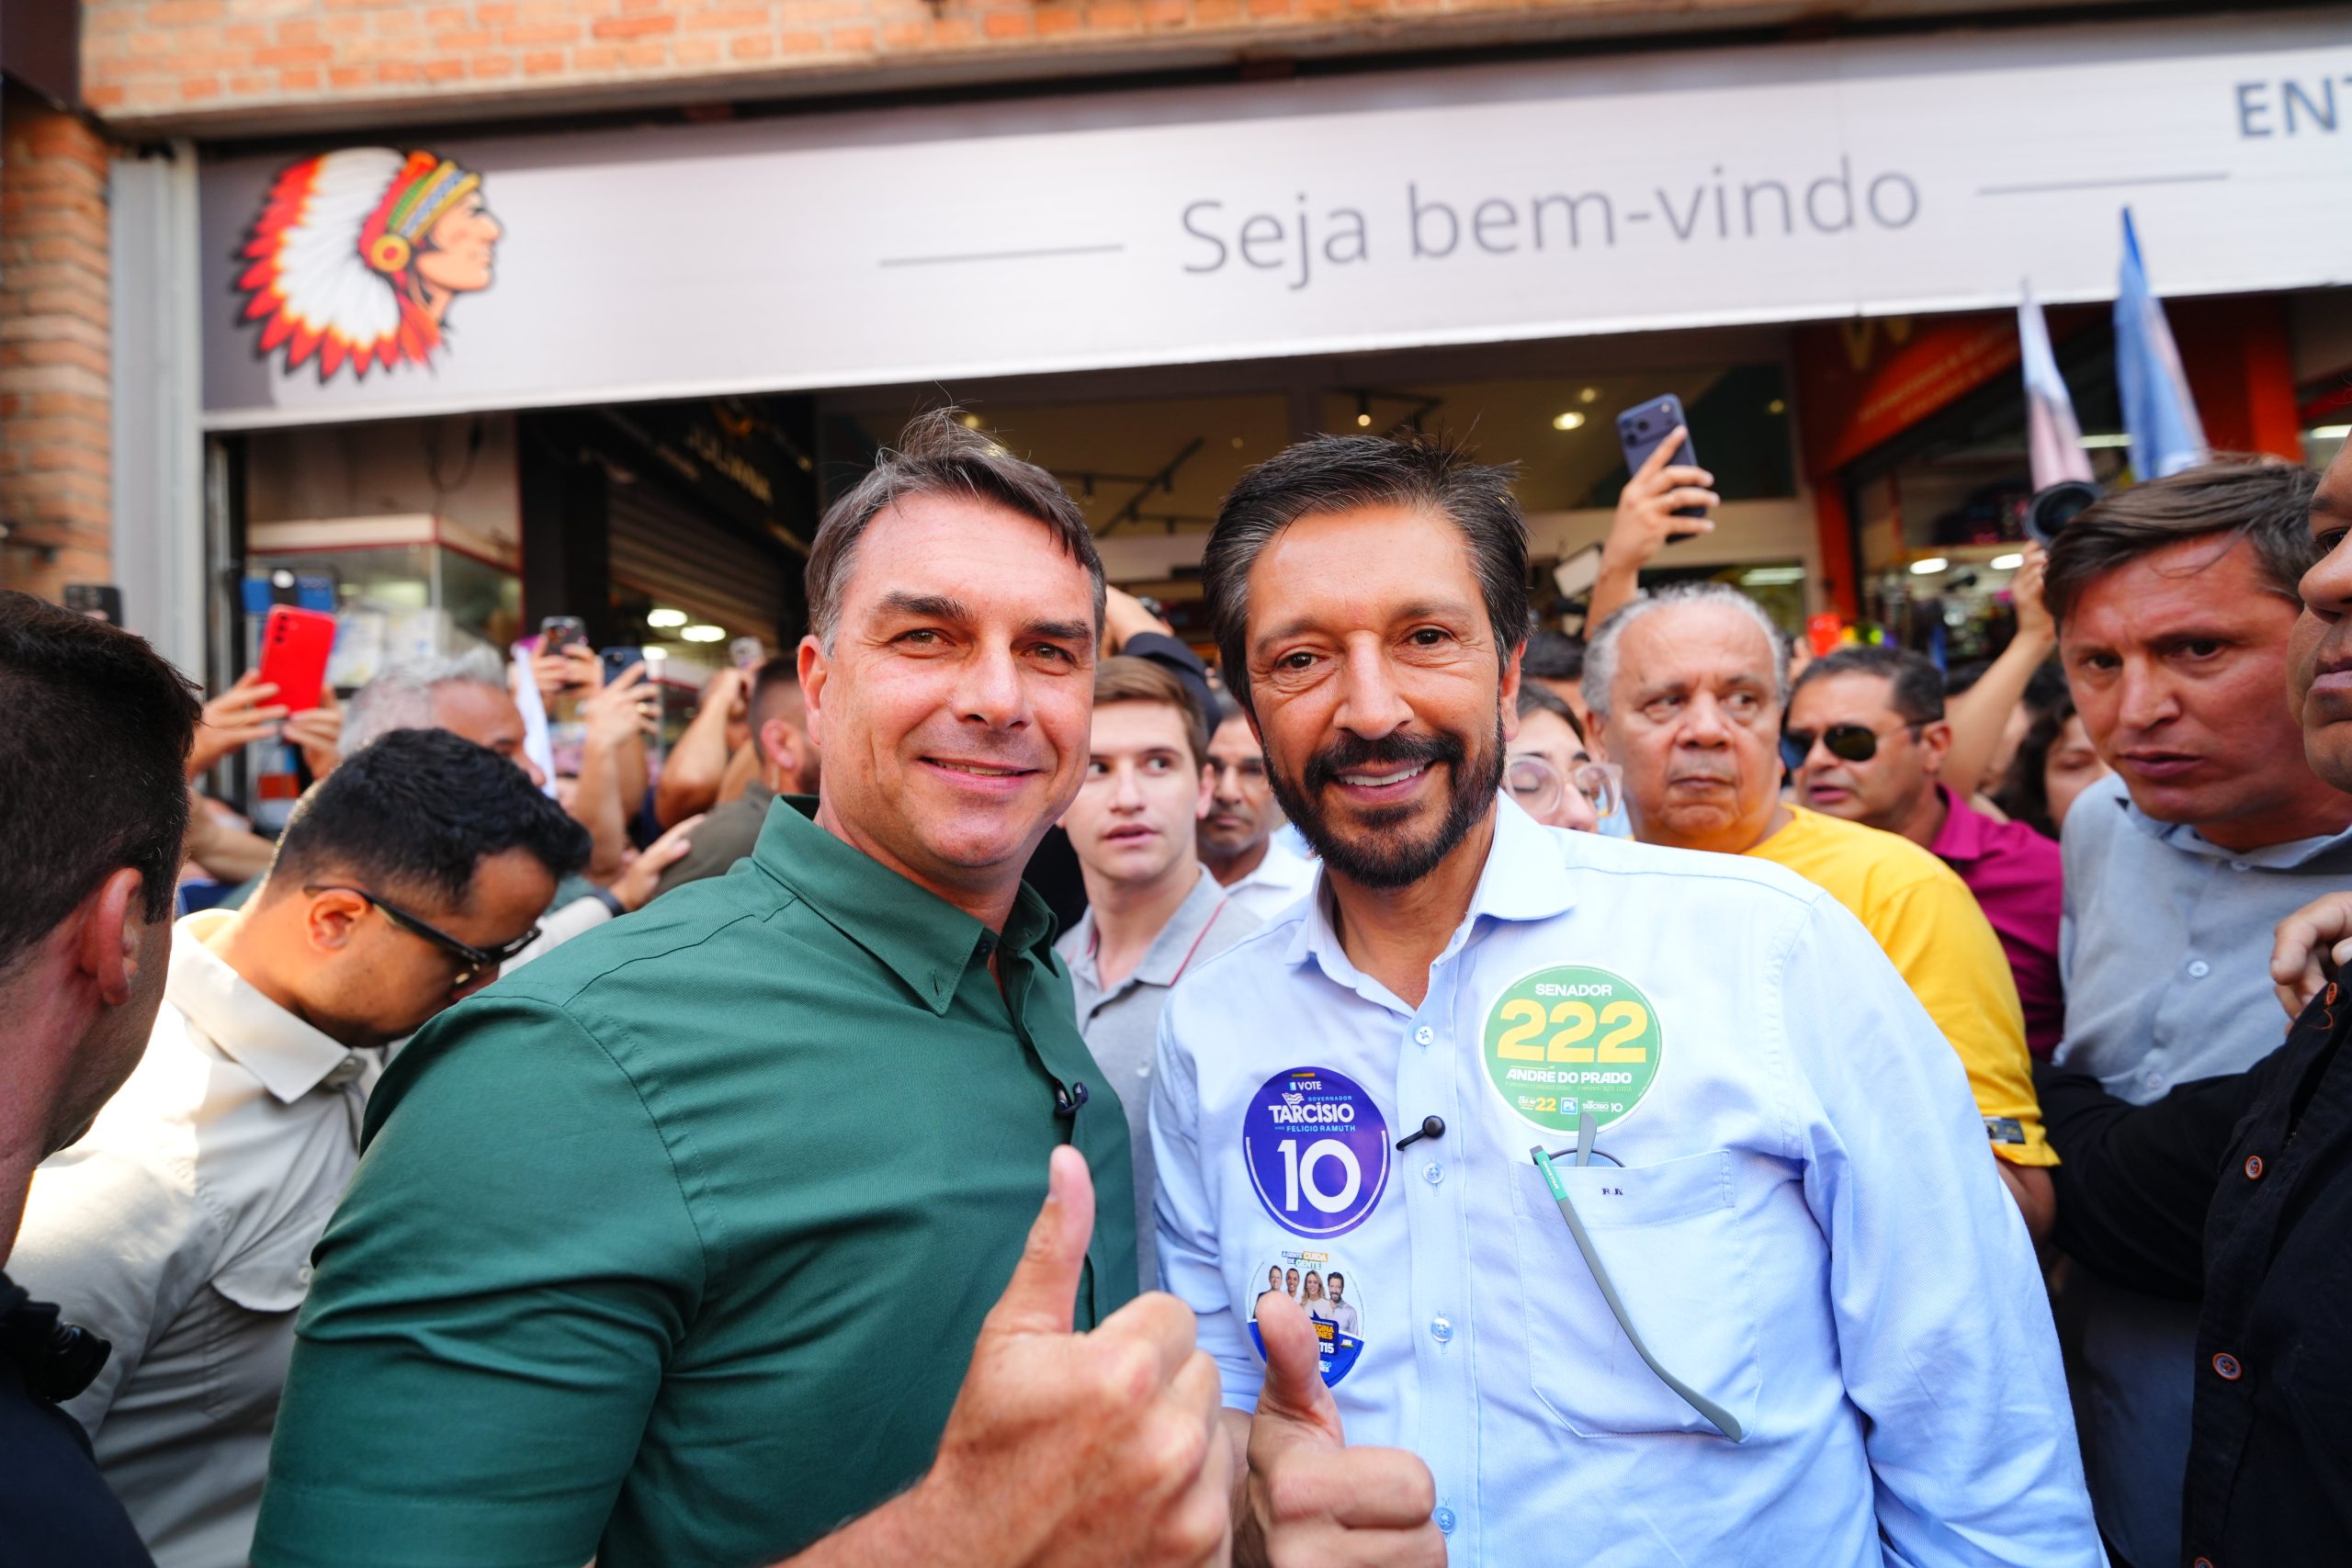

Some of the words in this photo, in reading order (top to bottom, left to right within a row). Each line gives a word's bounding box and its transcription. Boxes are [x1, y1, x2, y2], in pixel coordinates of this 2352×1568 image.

[2235, 76, 2352, 138] EN
[1181, 192, 1369, 292] Seja
[1407, 154, 1923, 261] bem-vindo
[1535, 984, 1612, 997] SENADOR
[1497, 998, 1648, 1063] 222
[1557, 1072, 1579, 1084] DO
[1580, 1072, 1633, 1084] PRADO
[1297, 1081, 1322, 1090] VOTE
[1534, 1097, 1556, 1111] 22
[1563, 1100, 1576, 1111] PL
[1611, 1102, 1623, 1112] 10
[1268, 1102, 1355, 1123] TARCÍSIO
[1276, 1138, 1362, 1213] 10
[1314, 1323, 1335, 1333] EGINA
[1319, 1341, 1335, 1354] 115
